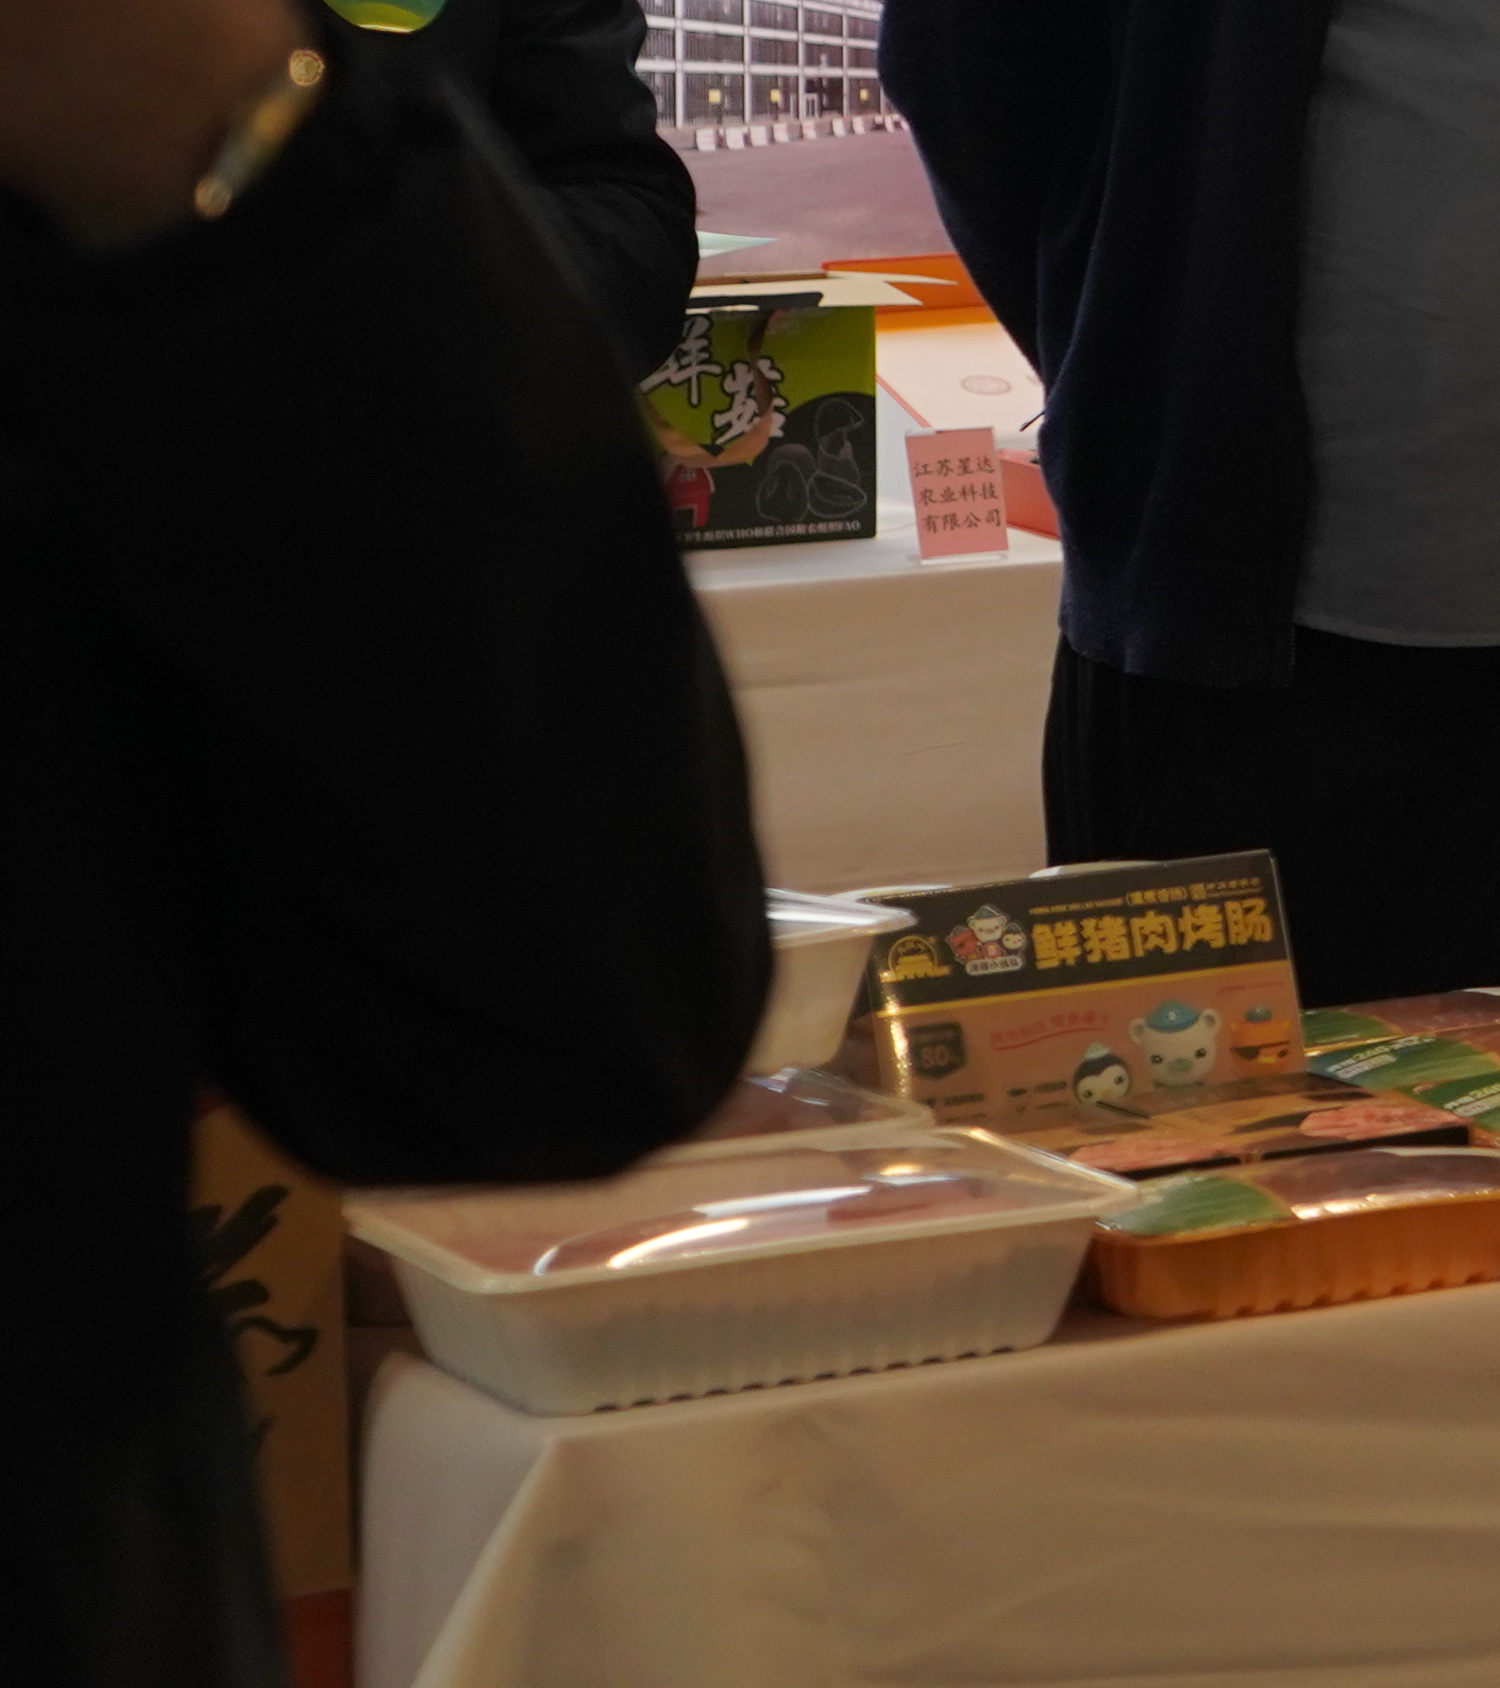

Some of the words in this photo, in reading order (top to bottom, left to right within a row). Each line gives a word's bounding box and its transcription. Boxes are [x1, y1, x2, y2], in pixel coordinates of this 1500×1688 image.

[914, 456, 996, 479] 江苏星达
[919, 483, 999, 505] 农业科技
[922, 510, 1002, 534] 有限公司
[1031, 897, 1272, 970] 鲜猪肉烤肠
